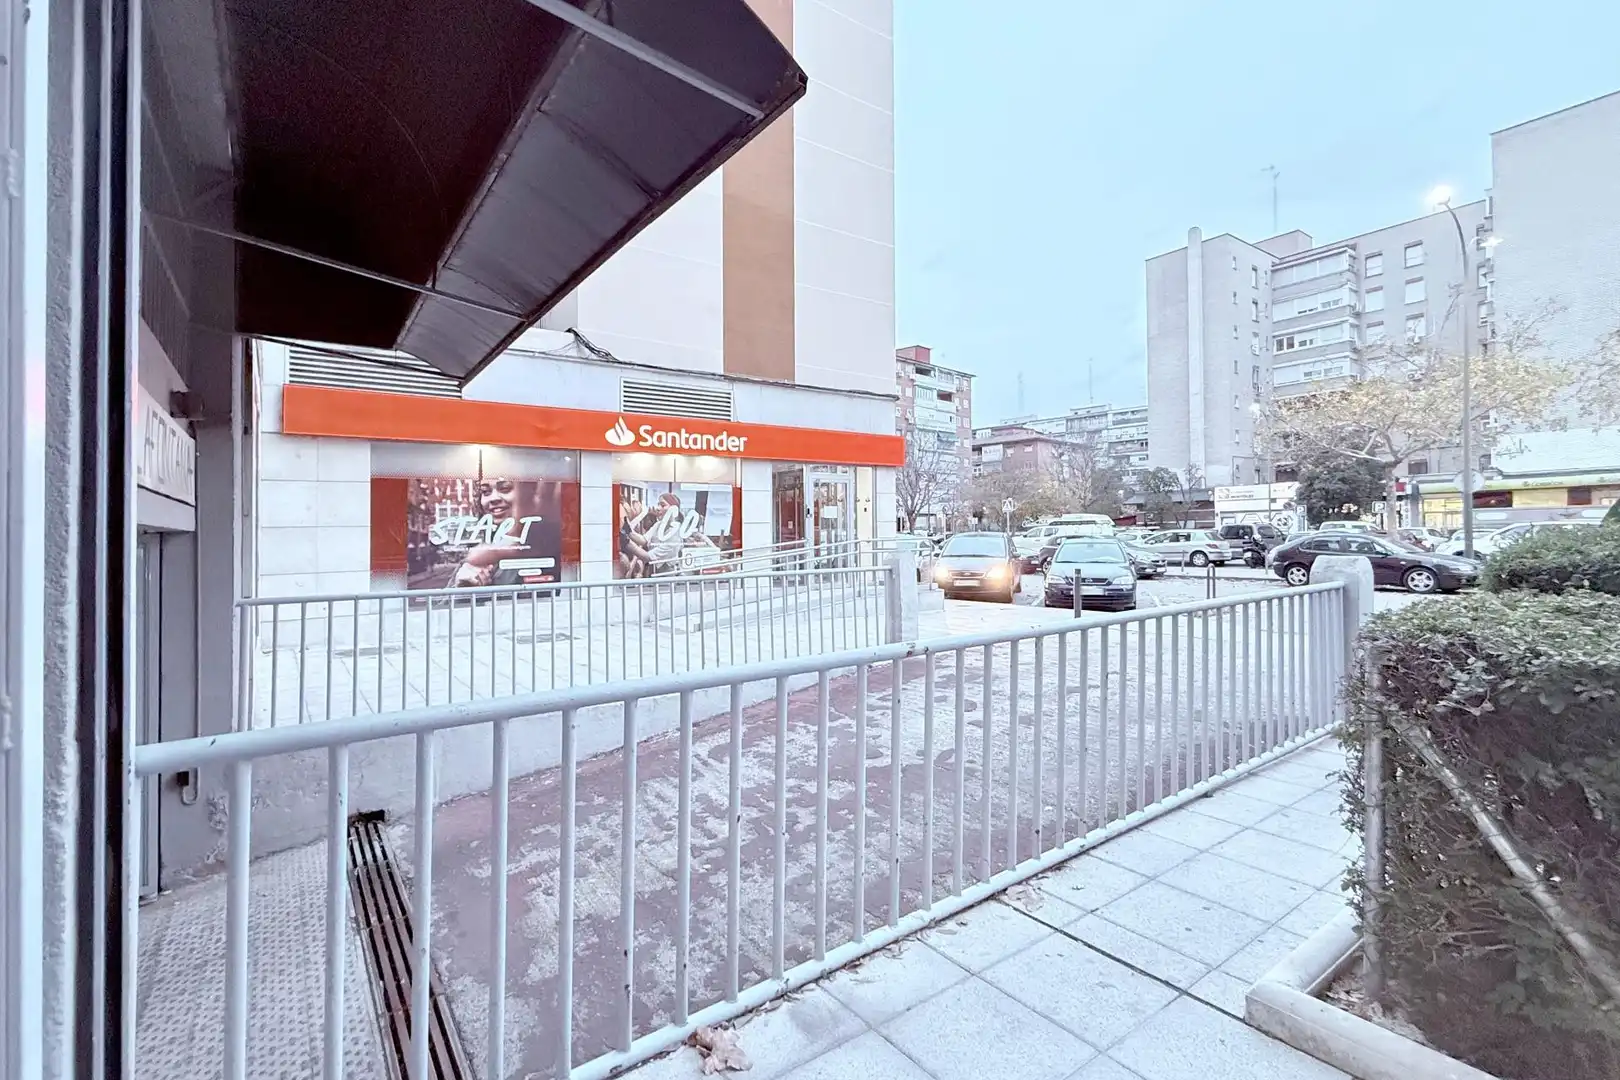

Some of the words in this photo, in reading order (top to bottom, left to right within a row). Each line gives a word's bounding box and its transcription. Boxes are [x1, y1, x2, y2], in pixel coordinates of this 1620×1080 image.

[639, 425, 748, 452] Santander
[429, 514, 542, 545] START
[658, 505, 700, 541] GO
